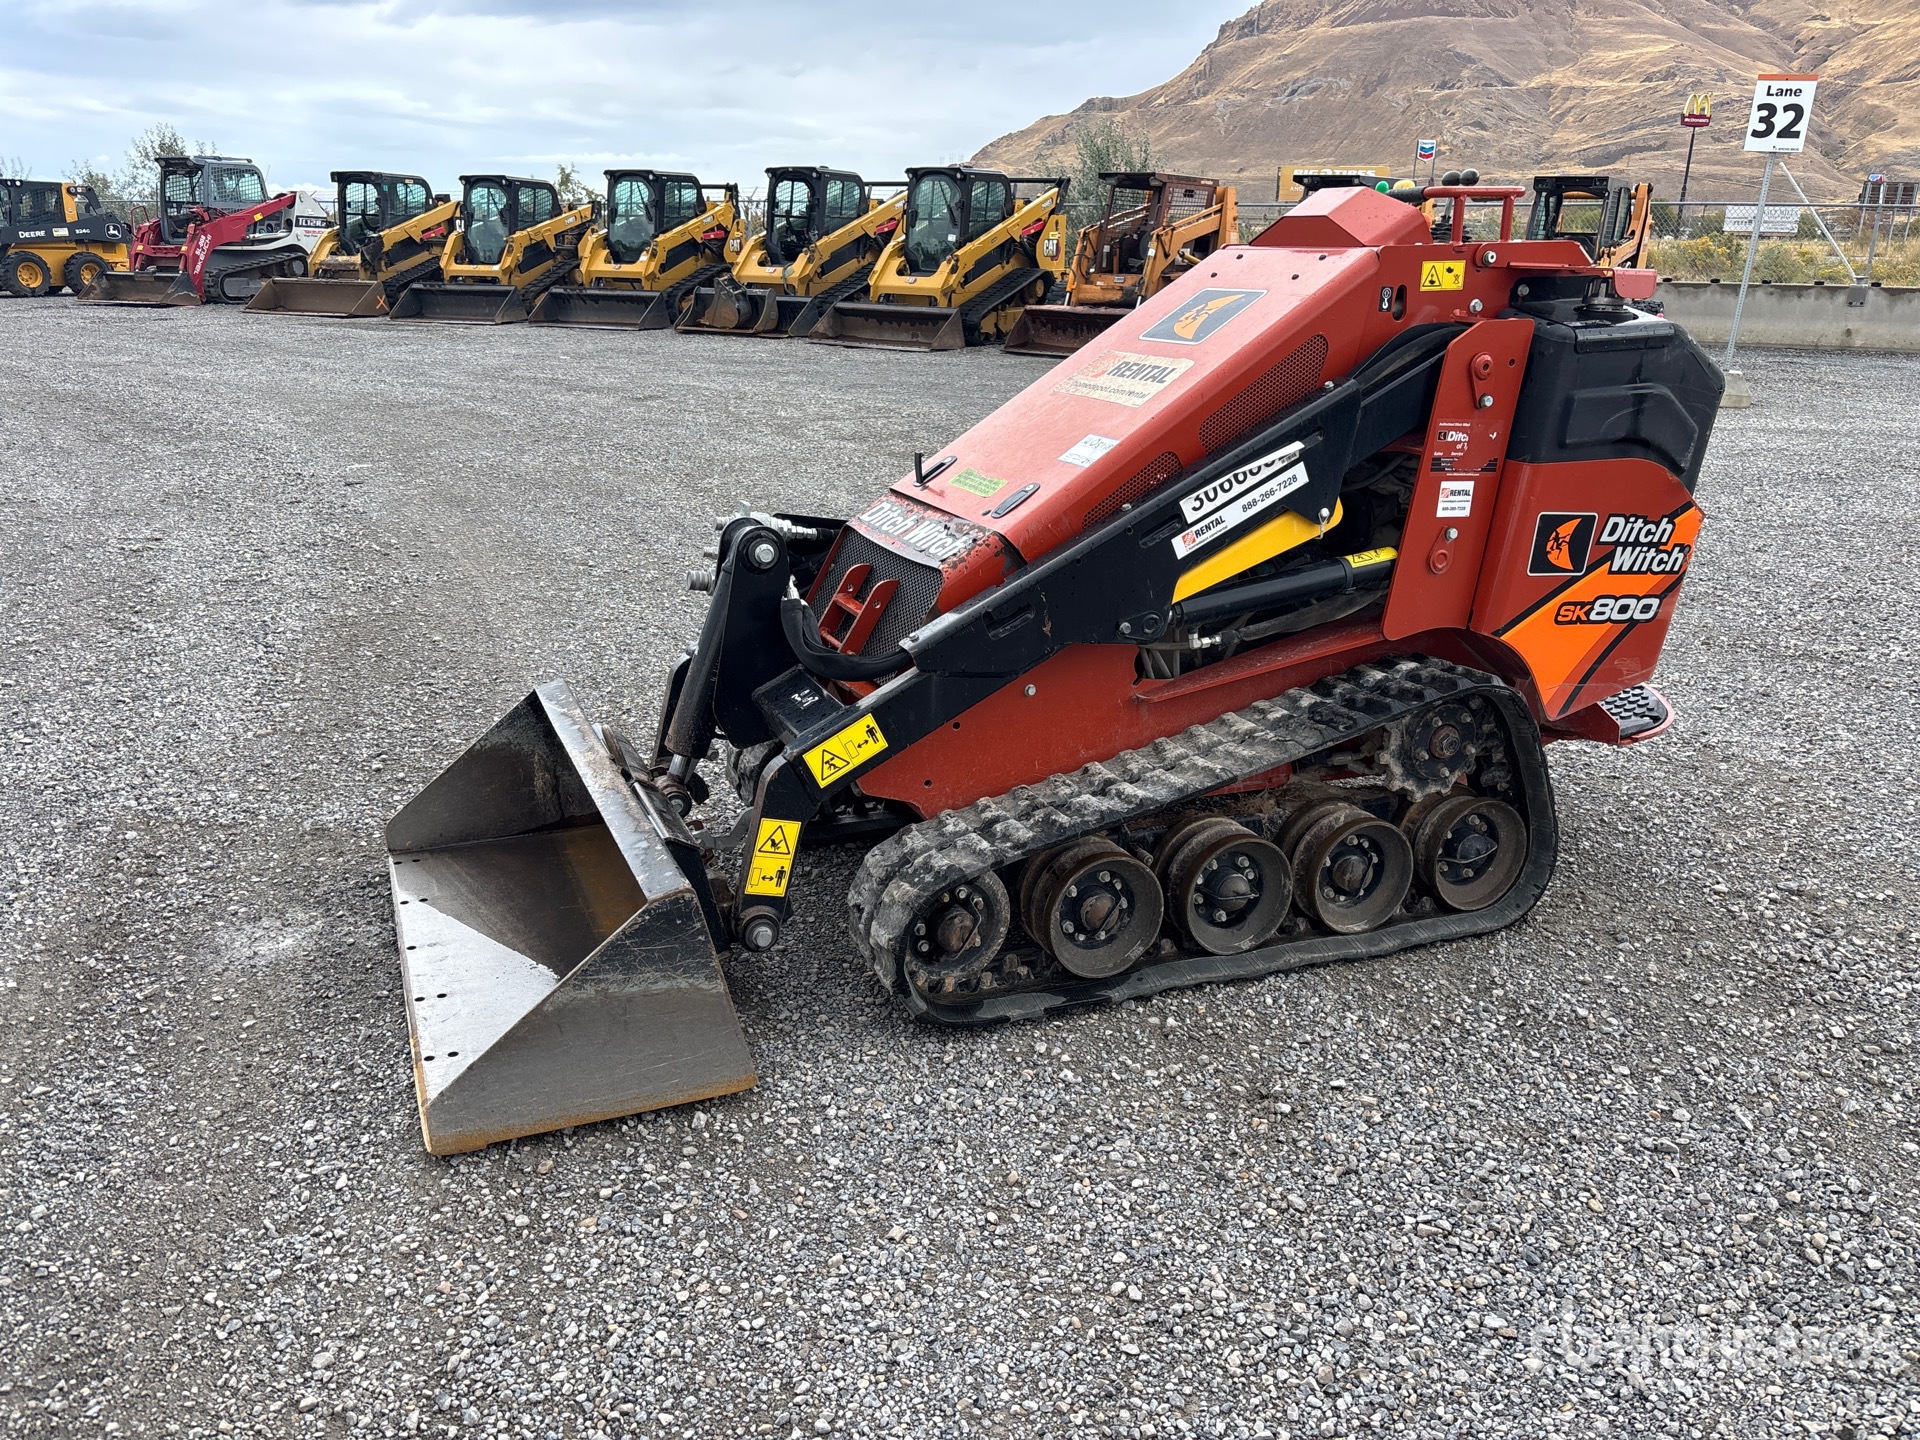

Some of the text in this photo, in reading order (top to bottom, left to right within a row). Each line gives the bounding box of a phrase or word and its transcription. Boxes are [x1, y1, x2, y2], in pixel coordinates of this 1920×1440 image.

[1766, 85, 1803, 97] Lane
[1750, 103, 1805, 139] 32
[18, 230, 46, 238] DEERE
[729, 239, 740, 252] CAT
[193, 234, 212, 275] TAKEUCHI
[1043, 239, 1059, 257] CAT
[1106, 361, 1177, 384] RENTAL
[1241, 474, 1298, 513] 888-266-7228
[1449, 489, 1471, 497] RENTAL
[859, 501, 918, 537] Ditch
[1194, 515, 1226, 539] RENTAL
[1600, 516, 1673, 543] Ditch
[1611, 546, 1685, 572] Witch
[1557, 598, 1660, 622] SK800
